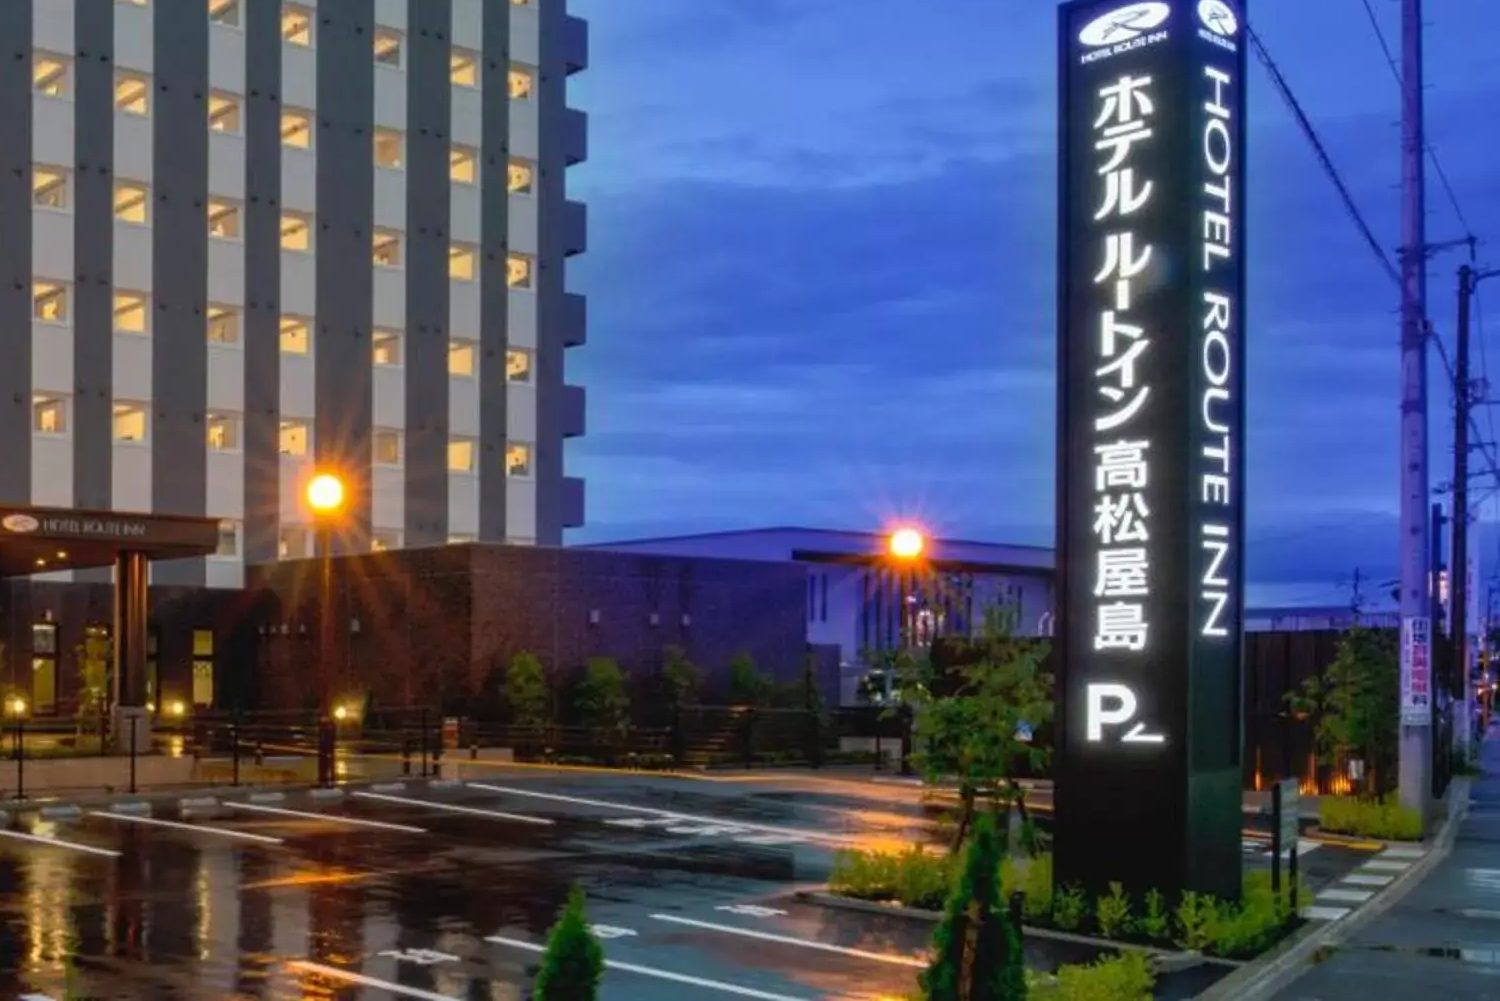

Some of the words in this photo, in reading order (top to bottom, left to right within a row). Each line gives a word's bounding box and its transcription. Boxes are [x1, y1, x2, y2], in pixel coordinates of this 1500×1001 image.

[1204, 66, 1231, 271] HOTEL
[1203, 292, 1230, 506] ROUTE
[1202, 523, 1229, 637] INN
[1086, 683, 1136, 741] P
